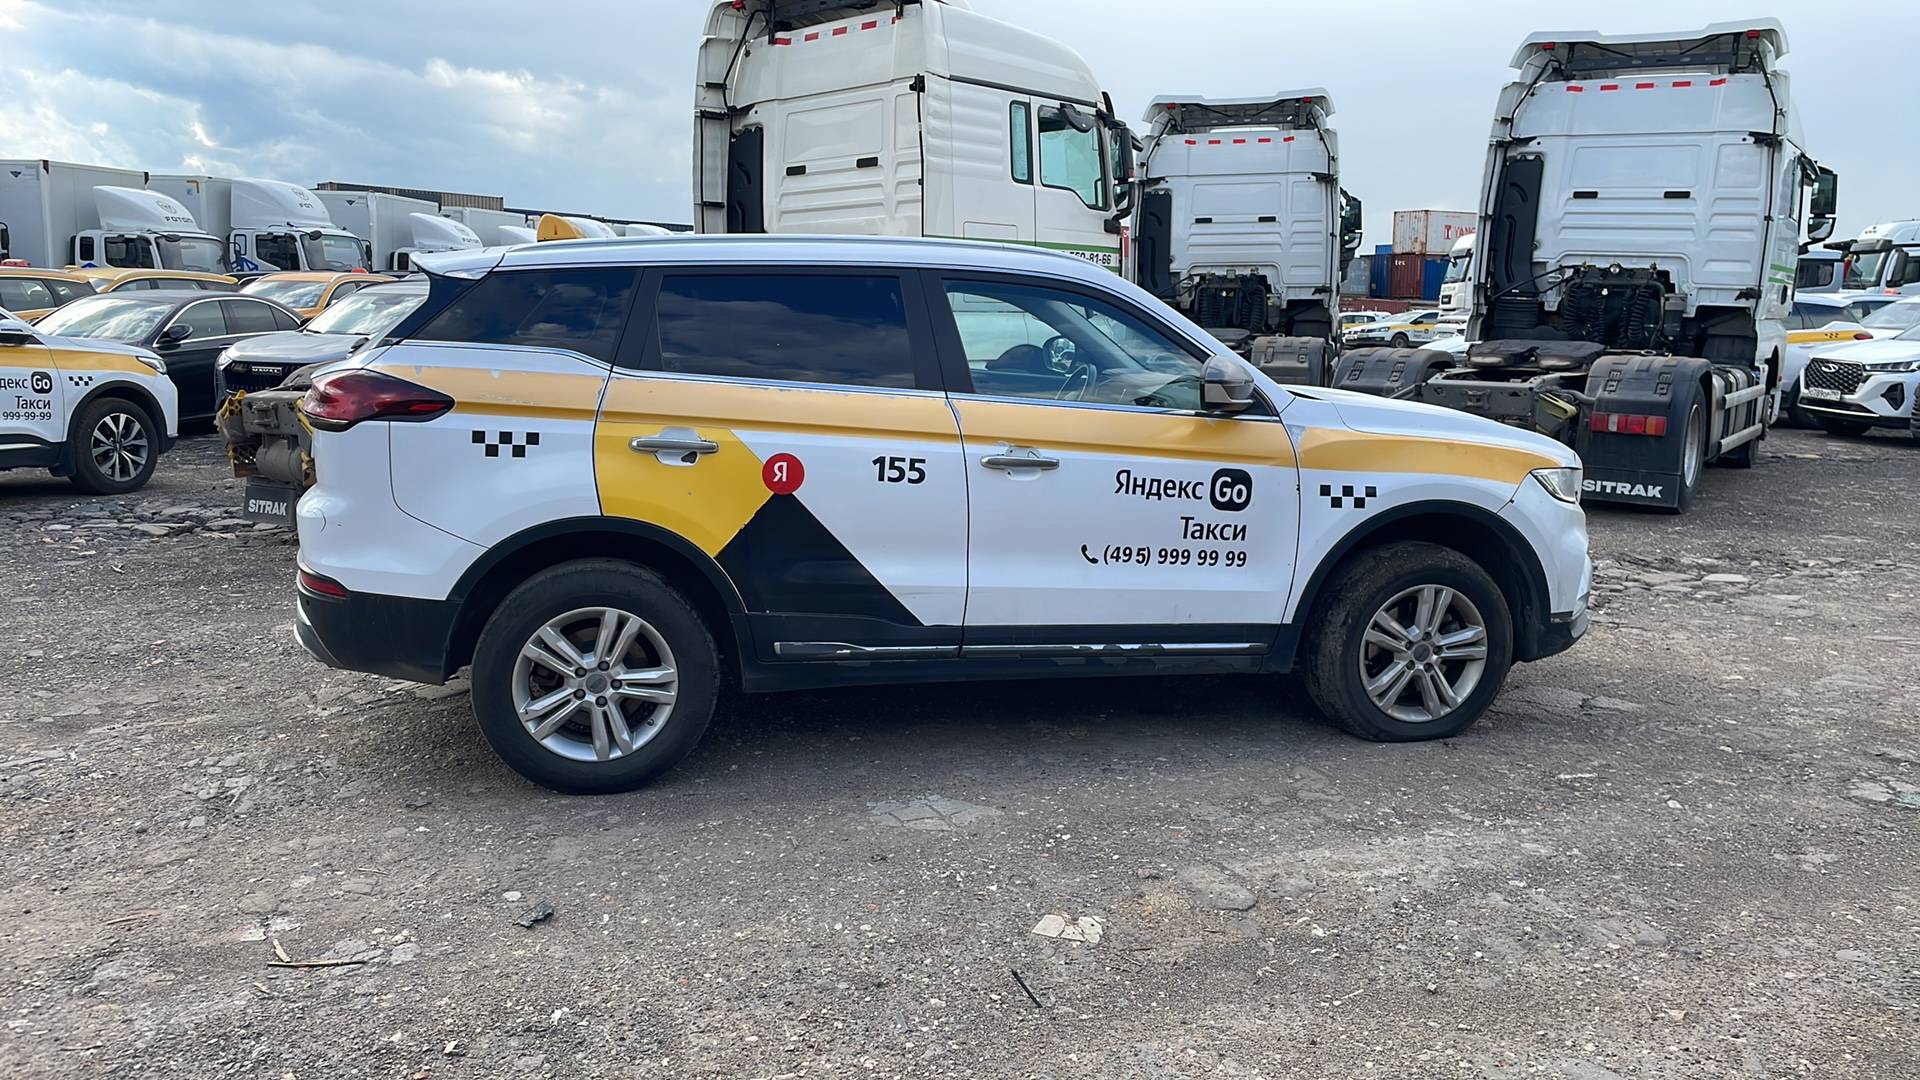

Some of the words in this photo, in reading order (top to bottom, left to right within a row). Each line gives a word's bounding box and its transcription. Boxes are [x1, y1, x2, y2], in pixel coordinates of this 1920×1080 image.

[32, 375, 51, 390] Go
[15, 395, 51, 410] Такси
[3, 411, 52, 421] 999-99-99
[773, 461, 788, 482] Я
[872, 455, 927, 485] 155
[1114, 469, 1205, 501] Яндекс
[1213, 475, 1249, 505] Go
[1582, 479, 1664, 498] SITRAK
[248, 498, 288, 516] SITRAK
[1180, 516, 1248, 542] Такси
[1103, 544, 1152, 567] (495)
[1157, 547, 1191, 566] 999
[1196, 549, 1219, 567] 99
[1225, 550, 1248, 568] 99
